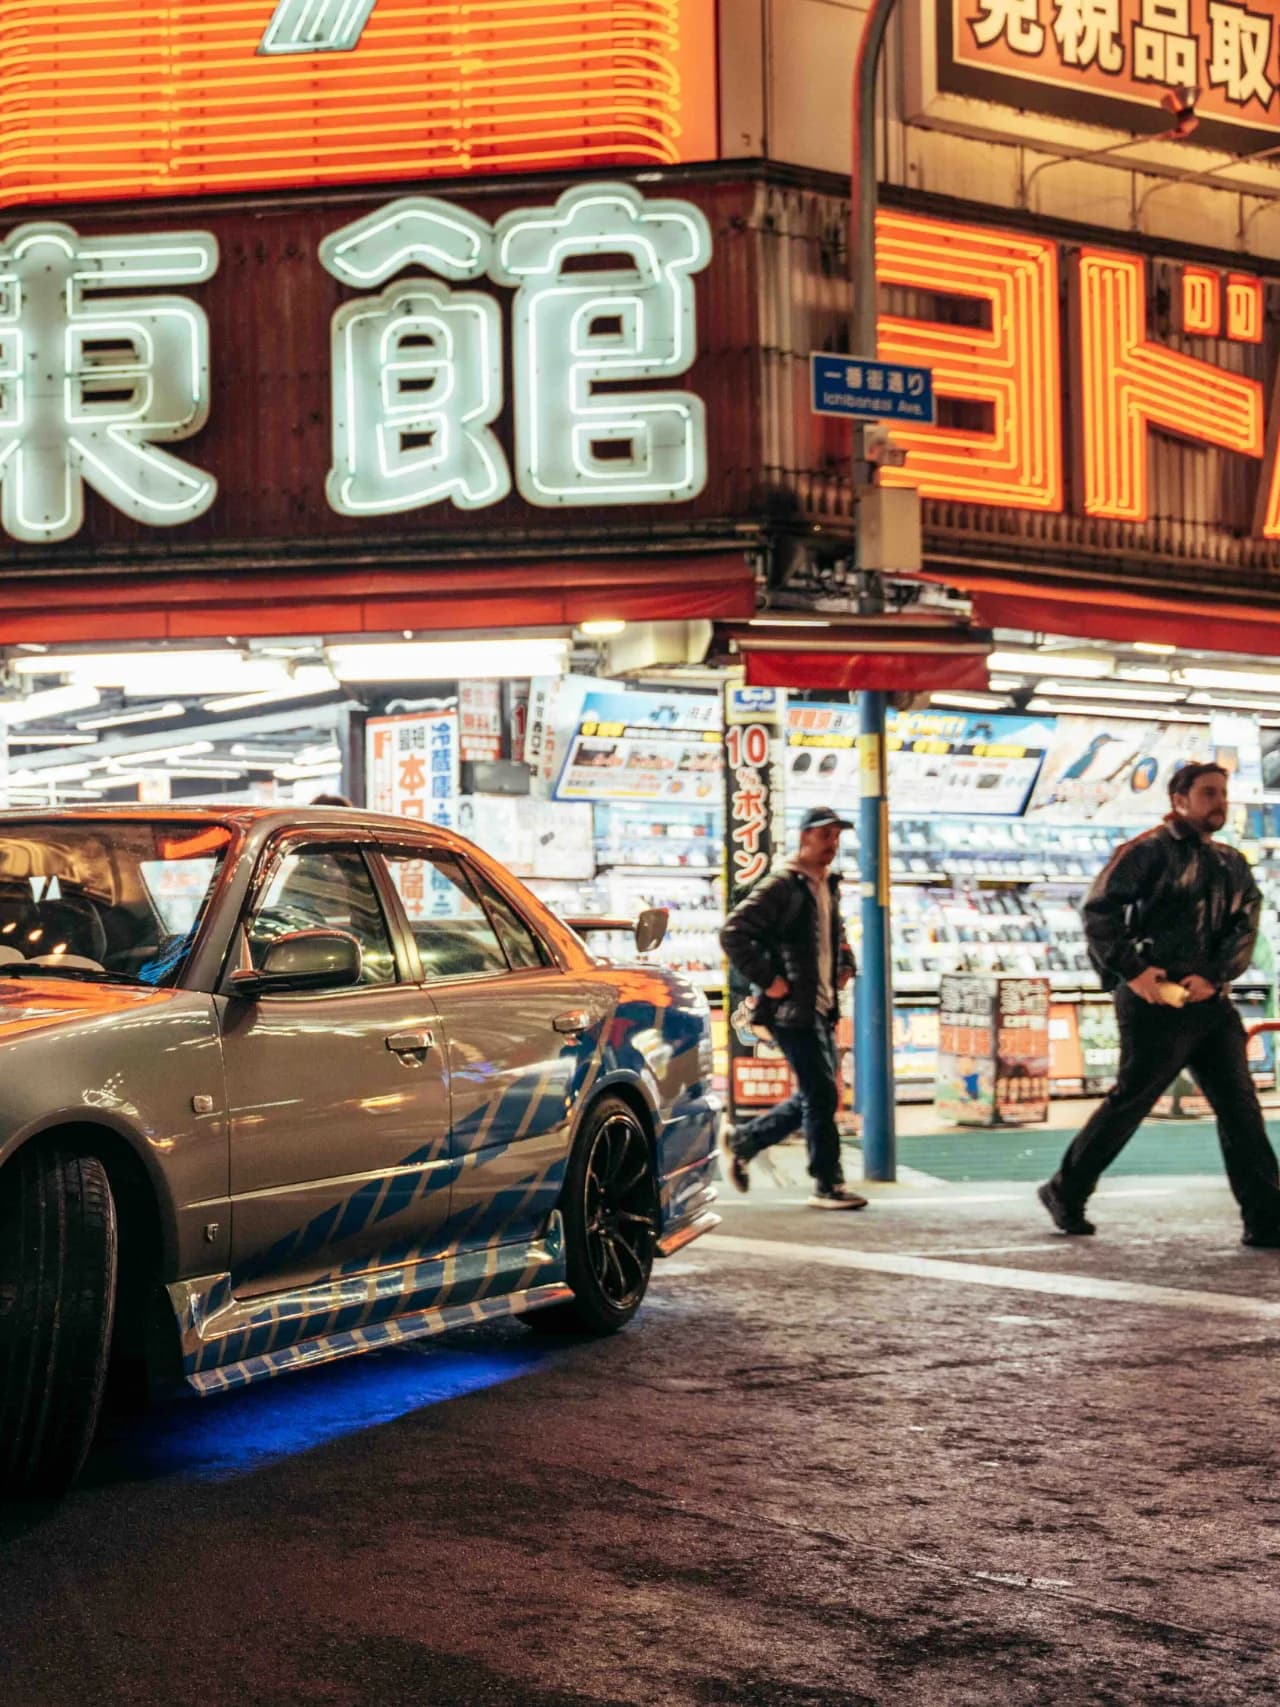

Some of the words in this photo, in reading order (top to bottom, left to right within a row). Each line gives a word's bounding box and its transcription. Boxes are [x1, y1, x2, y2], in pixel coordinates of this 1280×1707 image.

[823, 366, 925, 396] 一番街通り
[875, 208, 1280, 540] ヨド
